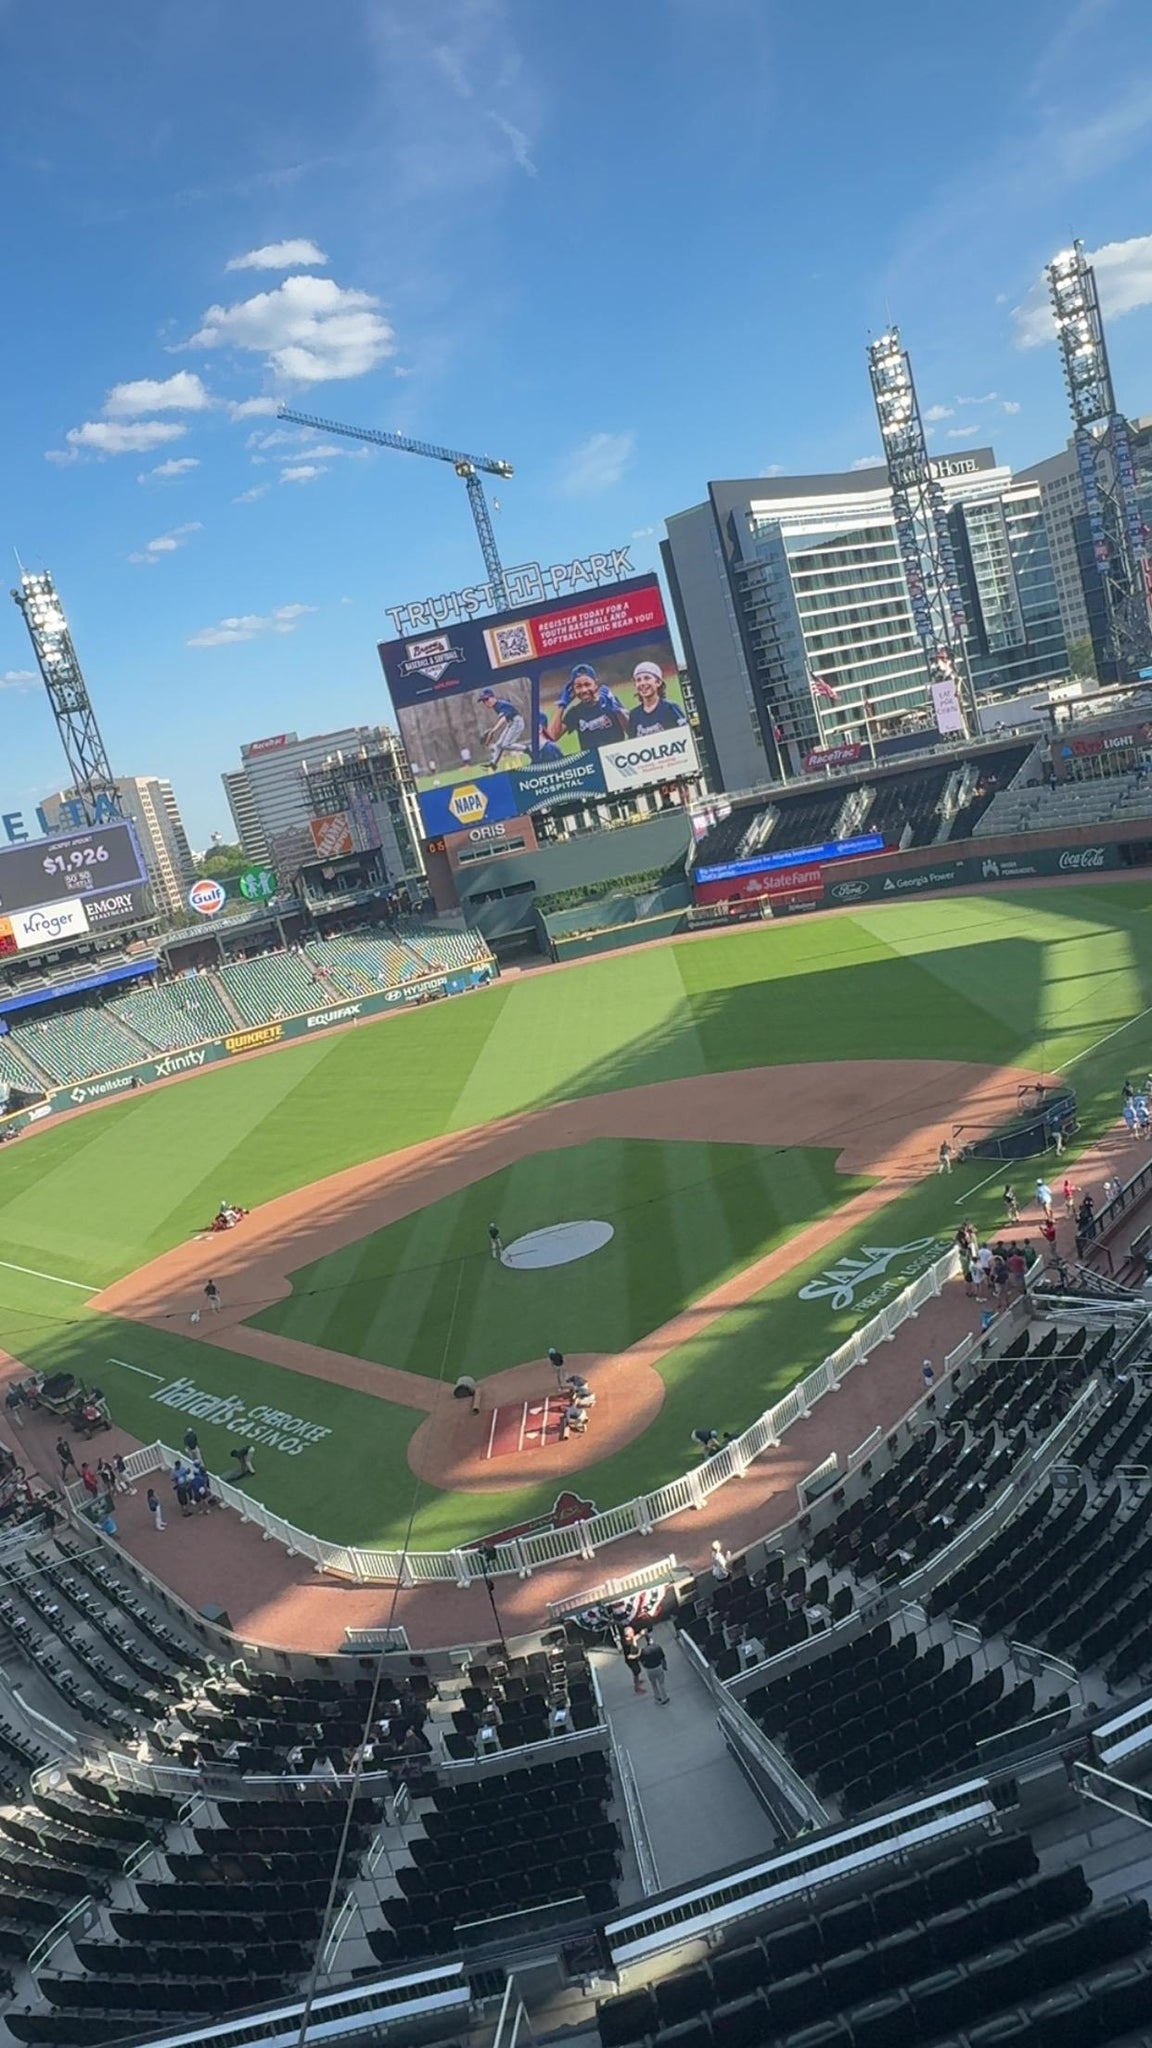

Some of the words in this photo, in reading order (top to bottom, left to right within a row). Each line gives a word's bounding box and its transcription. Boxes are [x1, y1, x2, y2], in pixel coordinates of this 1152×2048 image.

[938, 458, 979, 477] HOTEL
[385, 582, 497, 632] TRUIST
[550, 545, 636, 592] PARK
[538, 615, 578, 631] REGISTER
[579, 607, 605, 621] TODAY
[605, 603, 623, 615] FOR
[623, 601, 630, 610] A
[540, 622, 567, 640] YOUTH
[568, 616, 608, 632] BASEBALL
[609, 610, 627, 622] AND
[542, 629, 583, 648] SOFTBALL
[583, 622, 611, 637] CLINIC
[611, 616, 634, 630] NEAR
[634, 611, 654, 624] YOU!
[413, 640, 442, 657] Braves
[615, 739, 688, 769] COOLRAY
[1103, 735, 1134, 750] LIGHT
[808, 748, 855, 766] RaceTrac
[518, 763, 596, 791] NORTHSIDE
[535, 779, 584, 796] HOSPITAL
[454, 793, 484, 814] NAPA
[469, 823, 506, 842] ORIS
[43, 844, 109, 875] $1,926
[838, 884, 862, 896] Ford
[896, 875, 928, 888] Georgia
[929, 871, 955, 882] Power
[85, 893, 133, 916] EMORY
[191, 887, 222, 905] Gulf
[23, 912, 74, 936] Kroger
[403, 976, 448, 996] HYUNDAI
[307, 1004, 361, 1028] EQUIFAX
[226, 1025, 283, 1050] QUIKRETE
[155, 1050, 206, 1077] xfinity
[87, 1075, 134, 1097] Wellstar
[798, 1237, 934, 1310] SAIA
[851, 1280, 900, 1313] FREIGHT
[149, 1377, 246, 1425] Harrah's
[247, 1404, 333, 1442] CHEROKEE
[226, 1417, 312, 1456] CASINOS
